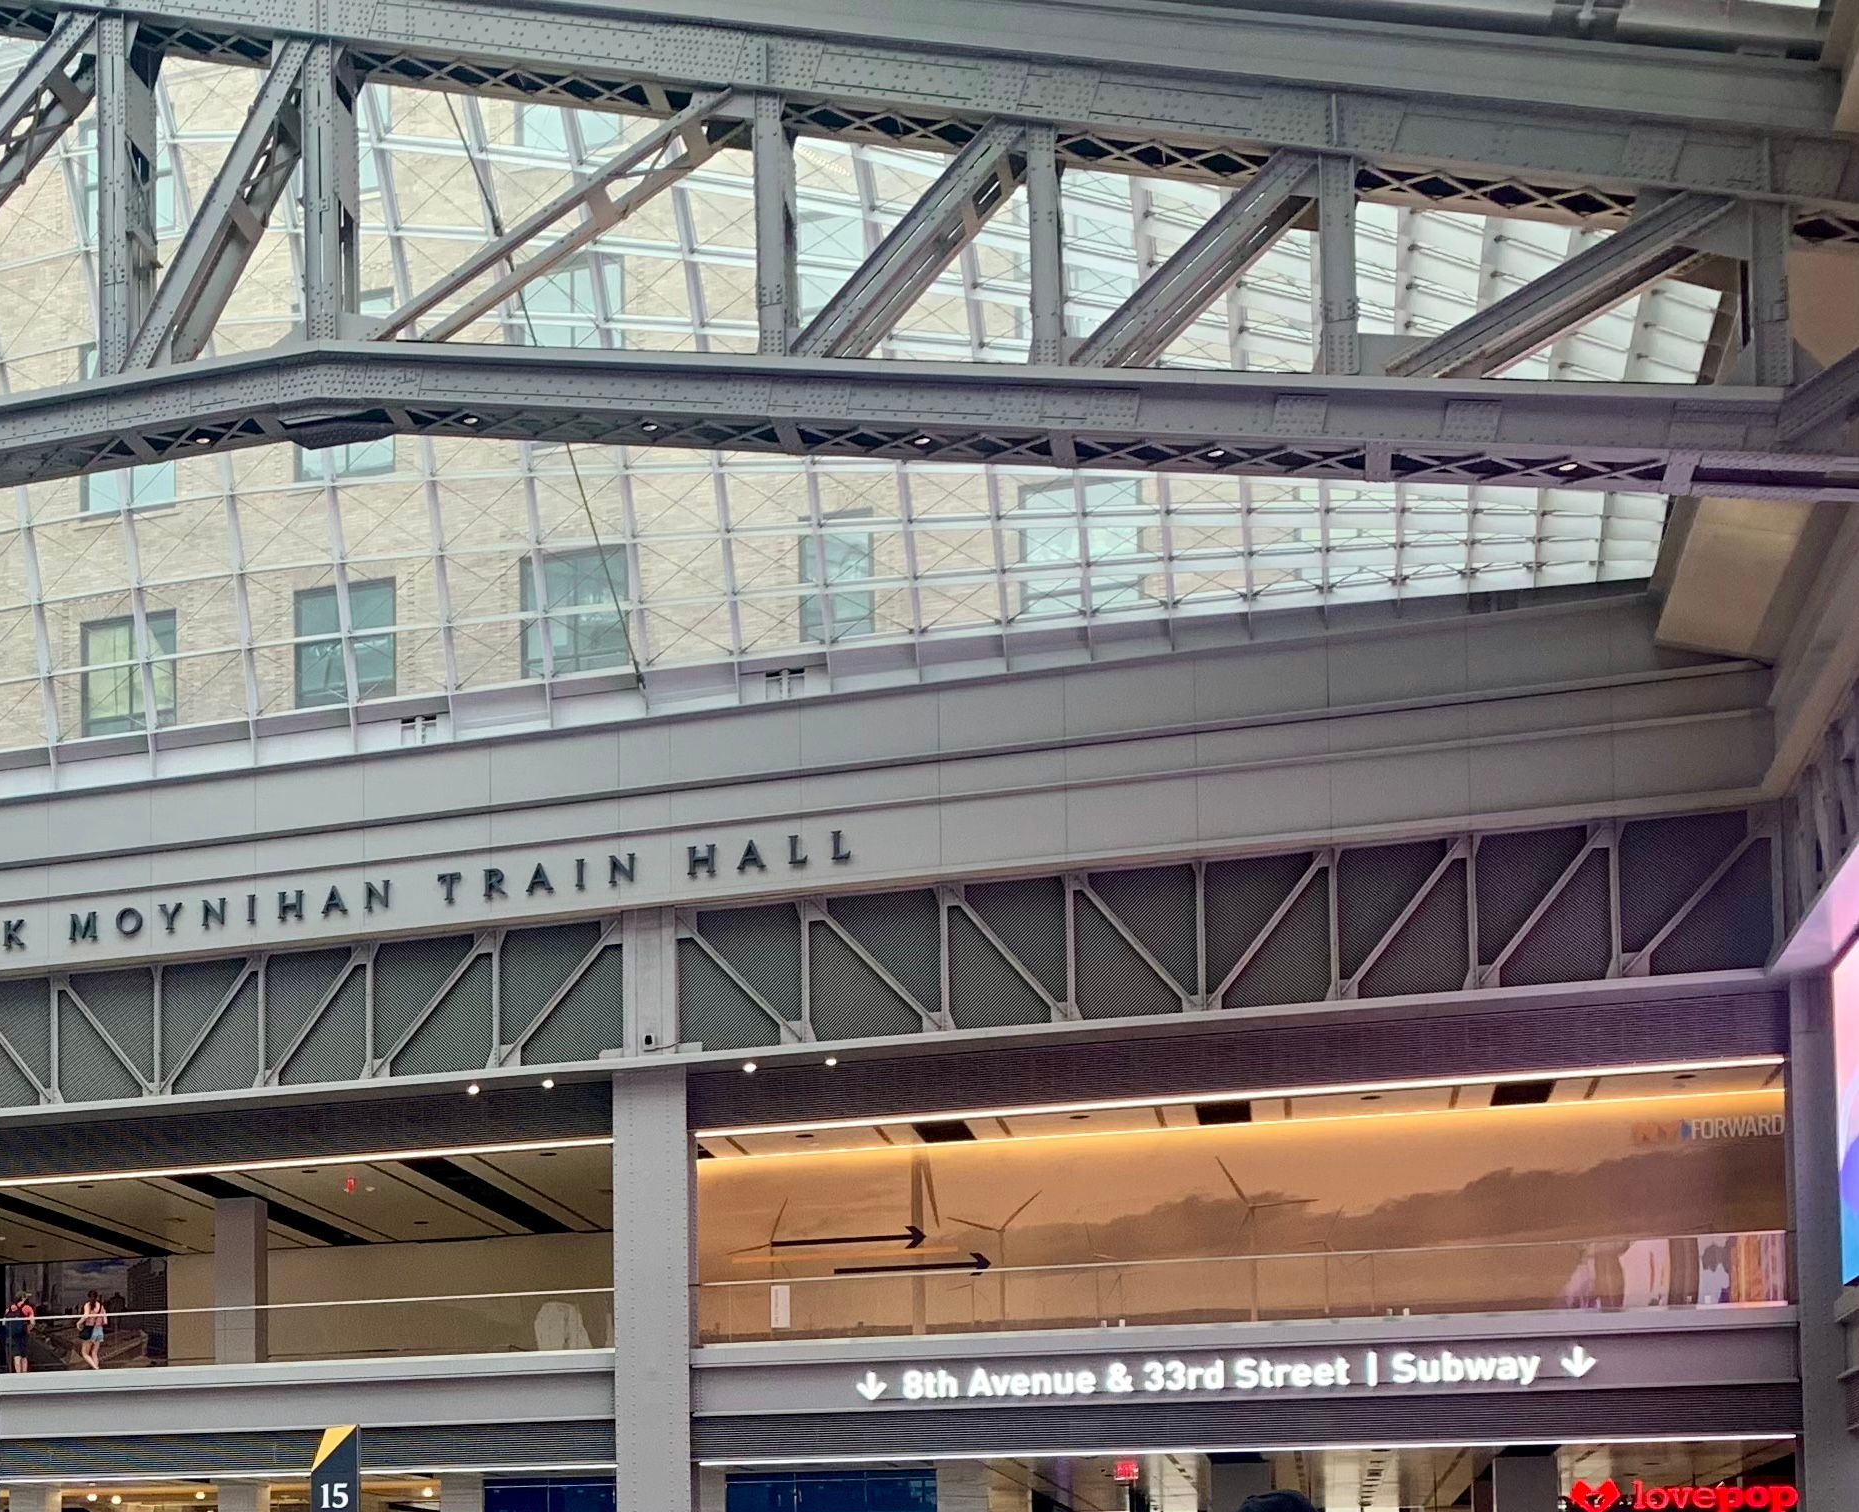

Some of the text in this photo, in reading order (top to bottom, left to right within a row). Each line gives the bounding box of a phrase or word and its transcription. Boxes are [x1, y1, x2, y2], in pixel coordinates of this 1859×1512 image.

[69, 878, 392, 941] MOYNIHAN
[437, 852, 636, 903] TRAIN
[687, 829, 852, 875] HALL
[1692, 1114, 1785, 1139] FORWARD
[902, 1369, 959, 1400] 8th
[967, 1368, 1097, 1397] Avenue
[1105, 1362, 1134, 1392] &
[1142, 1359, 1225, 1391] 33rd
[1234, 1357, 1350, 1389] Street
[1392, 1350, 1541, 1385] Subway
[320, 1482, 349, 1509] 15
